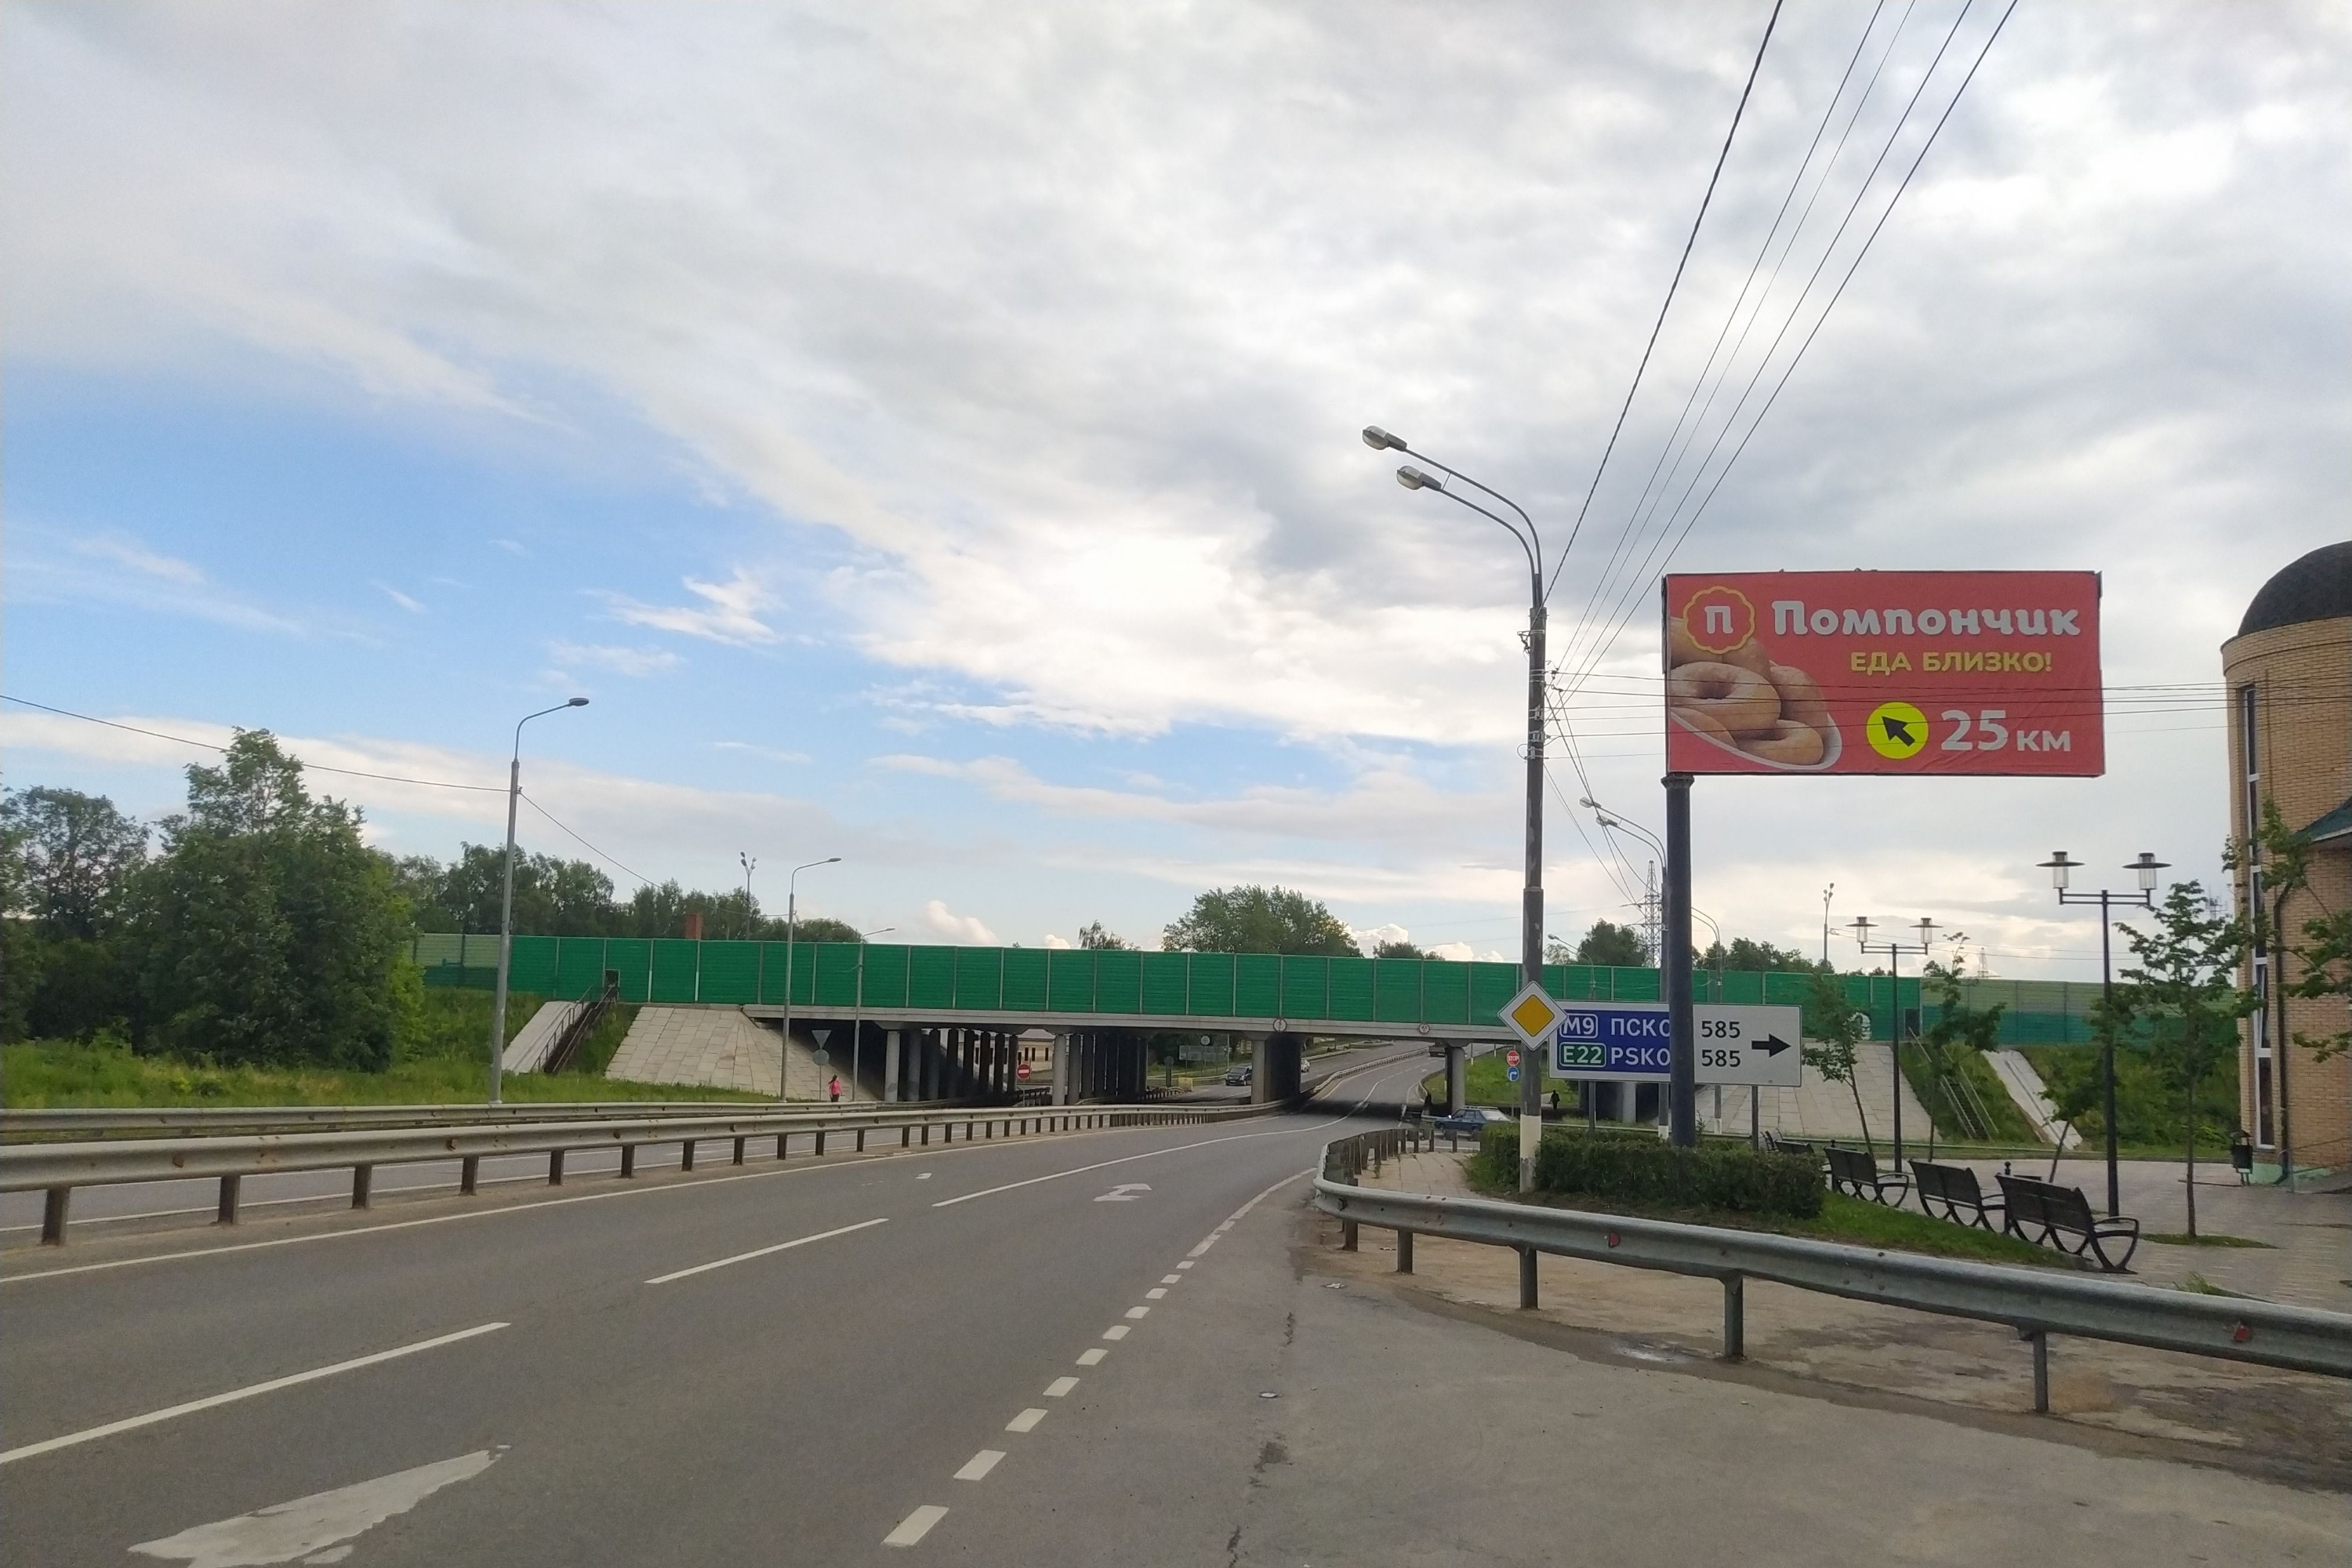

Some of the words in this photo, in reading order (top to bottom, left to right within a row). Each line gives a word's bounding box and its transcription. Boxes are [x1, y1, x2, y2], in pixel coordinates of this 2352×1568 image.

[1771, 600, 2081, 636] Помпончик
[1850, 652, 1912, 676] ЕДА
[1922, 652, 2053, 672] БЛИЗКО!
[1940, 709, 2009, 751] 25
[1610, 1018, 1671, 1037] ПСКО
[1701, 1020, 1740, 1039] 585
[1563, 1045, 1602, 1064] E22
[1610, 1047, 1671, 1066] PSKO
[1701, 1049, 1741, 1068] 585
